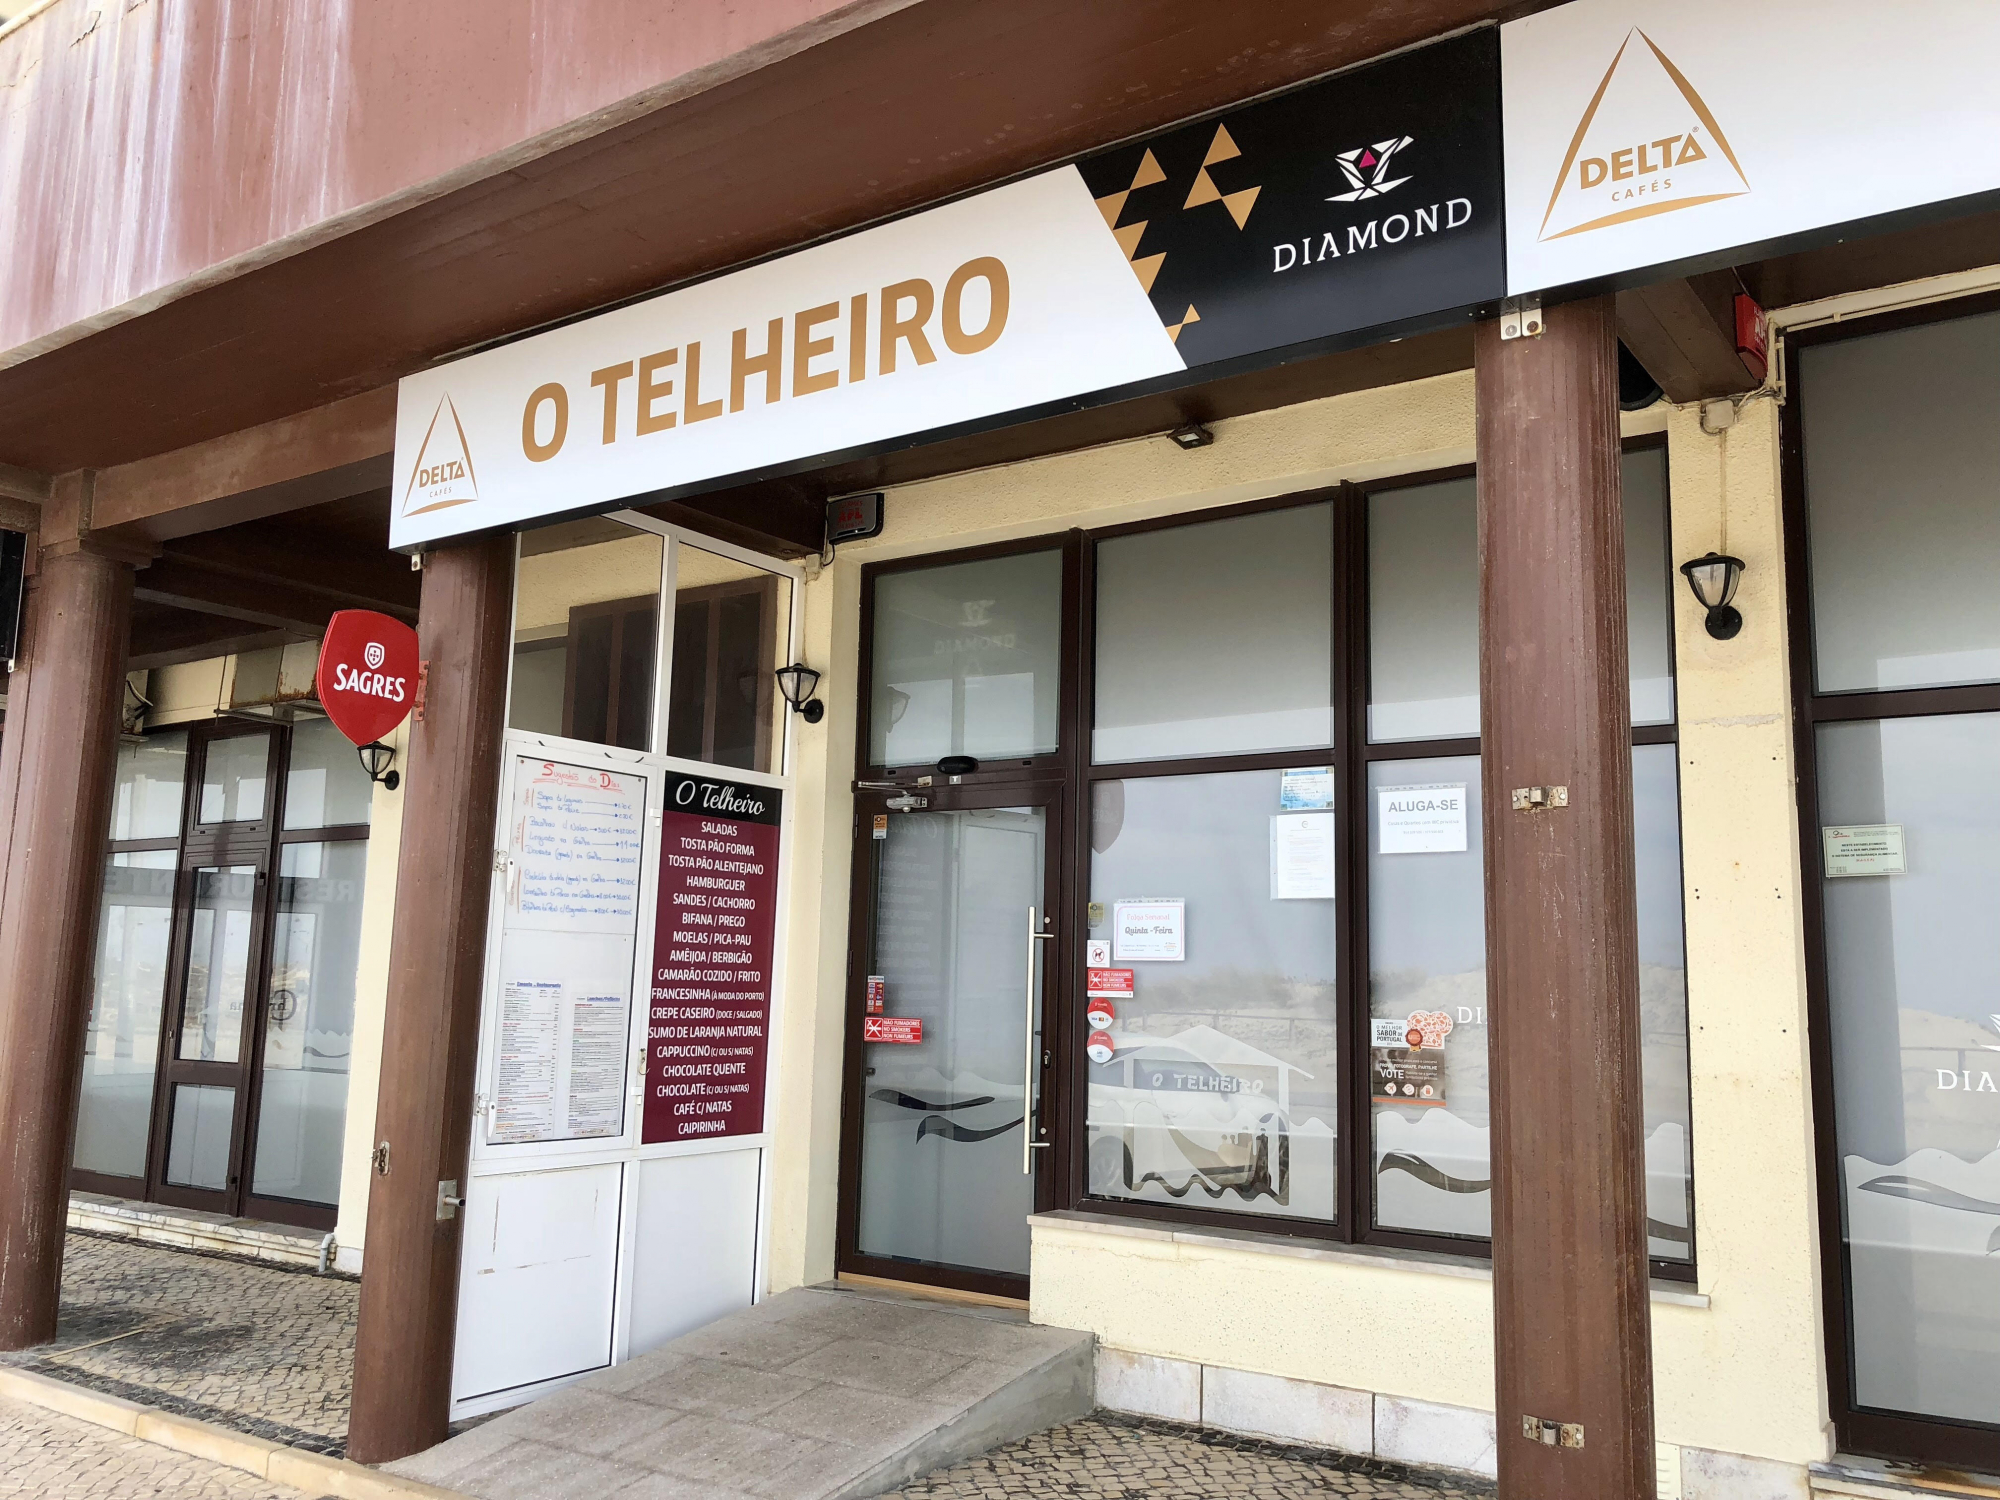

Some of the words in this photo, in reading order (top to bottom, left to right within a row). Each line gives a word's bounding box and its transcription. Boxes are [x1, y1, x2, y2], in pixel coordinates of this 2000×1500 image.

[1579, 132, 1708, 190] DELTA
[1611, 179, 1672, 202] CAFÉS
[1273, 197, 1472, 273] DIAMOND
[522, 382, 569, 463] O
[591, 256, 1010, 445] TELHEIRO
[419, 459, 466, 488] DELTA
[429, 486, 452, 498] CAFÉS
[333, 663, 406, 702] SAGRES
[675, 780, 696, 805] O
[700, 783, 765, 815] Telheiro
[1388, 799, 1459, 813] ALUGA-SE
[701, 821, 738, 836] SALADAS
[681, 837, 707, 851] TOSTA
[708, 840, 725, 853] PÃO
[726, 843, 755, 857] FORMA
[668, 855, 695, 868] TOSTA
[696, 856, 713, 870] PÃO
[714, 860, 764, 876] ALENTEJANO
[687, 875, 745, 891] HAMBURGUER
[673, 893, 707, 906] SANDES
[713, 896, 756, 910] CACHORRO
[682, 912, 713, 926] BIFANA
[718, 914, 745, 928] PREGO
[673, 931, 708, 944] MOELAS
[714, 933, 752, 946] PICA-PAU
[1125, 926, 1148, 936] Quinta
[669, 948, 706, 964] AMÊIJOA
[713, 950, 752, 964] BERBIGÃO
[658, 967, 701, 981] CAMARÃO
[702, 970, 732, 982] COZIDO
[738, 970, 761, 982] FRITO
[651, 987, 710, 1000] FRANCESINHA
[718, 992, 735, 1000] MODA
[745, 992, 764, 1001] PORTO)
[651, 1007, 678, 1019] CREPE
[680, 1007, 715, 1019] CASEIRO
[716, 1010, 732, 1020] (DOCE
[736, 1010, 762, 1019] SALGADO)
[649, 1026, 675, 1038] SUMO
[677, 1026, 688, 1038] DE
[690, 1026, 725, 1039] LARANJA
[727, 1026, 762, 1037] NATURAL
[657, 1045, 710, 1058] CAPPUCCINO
[719, 1048, 727, 1056] OU
[734, 1047, 753, 1056] NATAS)
[663, 1064, 711, 1077] CHOCOLATE
[713, 1063, 746, 1076] QUENTE
[1380, 1069, 1404, 1079] VOTE
[657, 1083, 706, 1097] CHOCOLATE
[715, 1085, 723, 1094] OU
[730, 1083, 749, 1093] NATAS)
[1152, 1072, 1163, 1087] O
[1173, 1074, 1264, 1093] TELHEIRO
[674, 1100, 695, 1115] CAFÉ
[706, 1101, 732, 1113] NATAS
[678, 1120, 726, 1135] CAIPIRINHA
